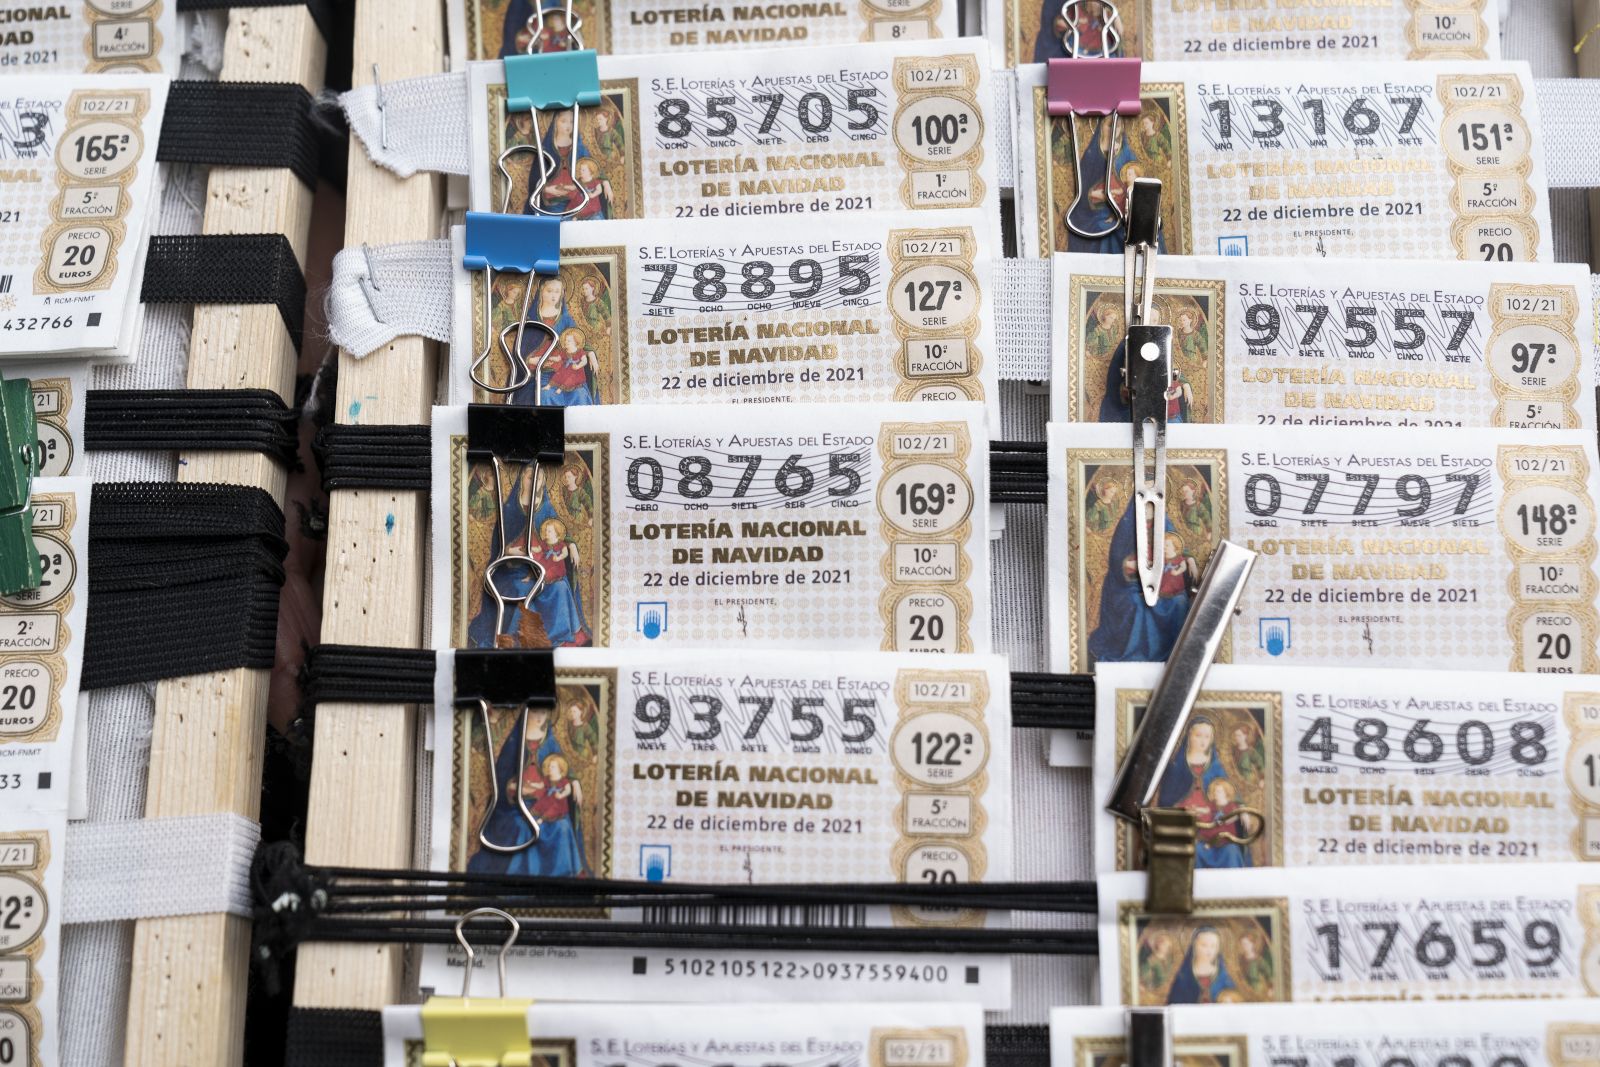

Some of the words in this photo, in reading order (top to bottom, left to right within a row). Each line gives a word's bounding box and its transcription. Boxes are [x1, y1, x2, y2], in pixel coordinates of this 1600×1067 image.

[631, 4, 726, 25] LOTERÍA
[736, 2, 847, 21] NACIONAL
[670, 31, 701, 45] DE
[706, 26, 808, 42] NAVIDAD
[1422, 30, 1470, 41] FRACCIÓN
[1184, 41, 1202, 52] 22
[1208, 39, 1227, 52] de
[1233, 37, 1310, 50] diciembre
[1318, 37, 1337, 49] de
[1342, 36, 1378, 48] 2021
[1, 53, 20, 65] de
[24, 50, 57, 64] 2021
[910, 69, 958, 82] 102/21
[1455, 86, 1501, 98] 102/21
[84, 101, 129, 111] 102/21
[657, 88, 879, 139] 85705
[1208, 98, 1422, 138] 13167
[927, 147, 952, 155] SERIE
[660, 154, 759, 176] LOTERÍA
[767, 151, 884, 171] NACIONAL
[1476, 156, 1500, 165] SERIE
[84, 166, 107, 175] SERIE
[702, 181, 733, 197] DE
[739, 177, 846, 195] NAVIDAD
[918, 188, 967, 199] FRACCIÓN
[676, 206, 693, 218] 22
[700, 203, 719, 217] de
[725, 200, 804, 215] diciembre
[810, 198, 830, 212] de
[836, 197, 872, 210] 2021
[1468, 196, 1517, 208] FRACCIÓN
[65, 204, 112, 216] FRACCIÓN
[1223, 209, 1242, 222] 22
[1248, 206, 1267, 220] de
[1273, 204, 1354, 220] diciembre
[1360, 203, 1380, 217] de
[1386, 202, 1422, 216] 2021
[68, 231, 100, 240] PRECIO
[1478, 227, 1512, 237] PRECIO
[905, 242, 954, 253] 102/21
[62, 245, 95, 266] 20
[644, 255, 871, 304] 78895
[1507, 298, 1556, 311] 102/21
[923, 317, 947, 325] SERIE
[1245, 303, 1475, 351] 97557
[648, 322, 747, 345] LOTERÍA
[757, 319, 879, 338] NACIONAL
[690, 351, 722, 368] DE
[729, 344, 839, 364] NAVIDAD
[912, 360, 962, 371] FRACCIÓN
[662, 377, 679, 390] 22
[687, 374, 706, 389] de
[713, 371, 795, 387] diciembre
[800, 370, 820, 383] de
[826, 368, 864, 382] 2021
[1522, 376, 1546, 386] SERIE
[922, 392, 956, 401] PRECIO
[898, 437, 947, 449] 102/21
[1515, 459, 1566, 471] 102/21
[628, 454, 861, 500] 08765
[1245, 473, 1480, 516] 07797
[635, 504, 659, 512] CERO
[832, 500, 858, 508] CINCO
[630, 518, 733, 540] LOTERÍA
[742, 519, 866, 538] NACIONAL
[913, 518, 938, 528] SERIE
[1537, 537, 1562, 546] SERIE
[673, 548, 705, 564] DE
[712, 546, 823, 563] NAVIDAD
[900, 564, 951, 576] FRACCIÓN
[644, 573, 663, 587] 22
[669, 572, 689, 586] de
[695, 570, 779, 585] diciembre
[785, 570, 805, 584] de
[812, 570, 851, 583] 2021
[1265, 589, 1284, 603] 22
[1291, 588, 1311, 603] de
[1318, 588, 1403, 603] diciembre
[1410, 588, 1431, 602] de
[1438, 588, 1477, 602] 2021
[1526, 583, 1578, 594] FRACCIÓN
[909, 599, 944, 607] PRECIO
[909, 615, 944, 640] 20
[1536, 617, 1571, 626] PRECIO
[0, 637, 50, 647] FRACCIÓN
[1537, 633, 1570, 660] 20
[4, 669, 39, 678] PRECIO
[1, 685, 35, 710] 20
[914, 684, 966, 697] 102/21
[634, 694, 876, 742] 93755
[1298, 717, 1547, 765] 48608
[633, 760, 739, 781] LOTERÍA
[748, 766, 878, 784] NACIONAL
[927, 768, 954, 778] SERIE
[676, 790, 710, 807] DE
[717, 791, 833, 809] NAVIDAD
[1304, 785, 1413, 805] LOTERÍA
[1423, 791, 1554, 807] NACIONAL
[647, 816, 667, 829] 22
[673, 815, 694, 830] de
[701, 816, 787, 831] diciembre
[793, 817, 815, 832] de
[822, 819, 862, 833] 2021
[912, 816, 967, 829] FRACCIÓN
[1349, 815, 1383, 832] DE
[1391, 816, 1509, 833] NAVIDAD
[1318, 839, 1338, 853] 22
[1345, 839, 1366, 854] de
[1374, 839, 1459, 855] diciembre
[1469, 841, 1490, 856] de
[1499, 842, 1539, 856] 2021
[922, 851, 958, 861] PRECIO
[1316, 919, 1561, 968] 17659
[664, 957, 948, 982] 5102105122>0937559400
